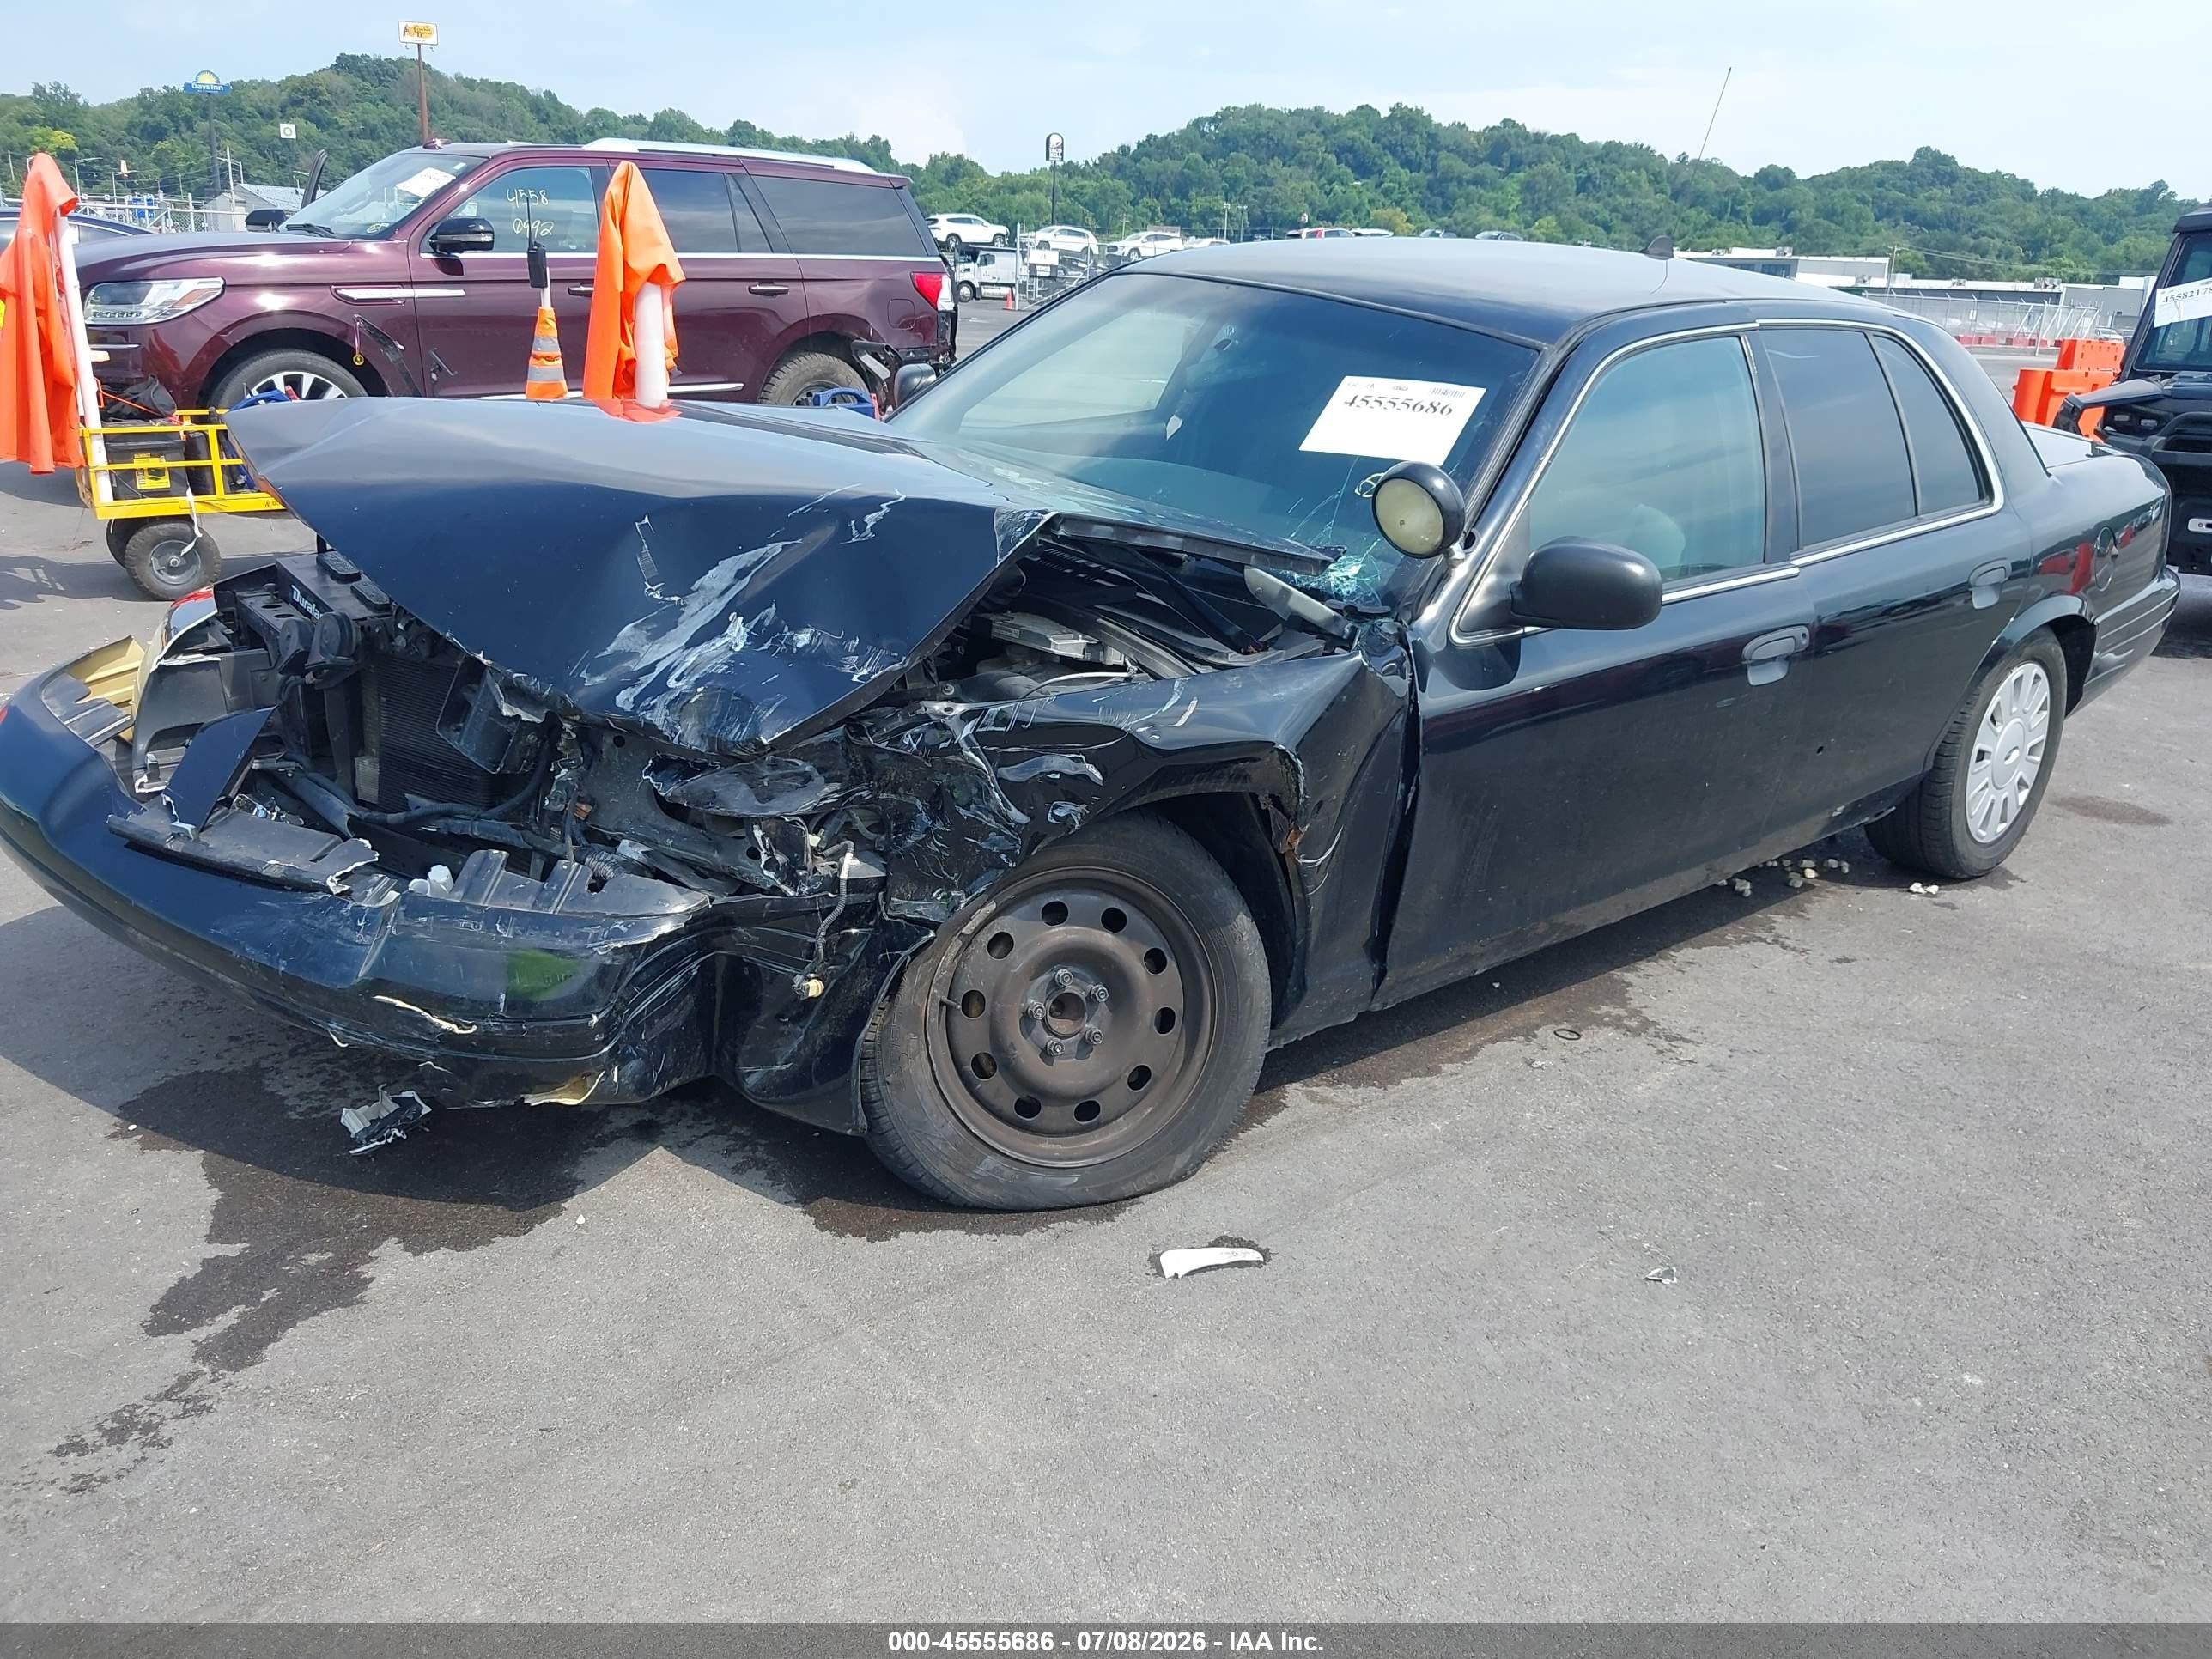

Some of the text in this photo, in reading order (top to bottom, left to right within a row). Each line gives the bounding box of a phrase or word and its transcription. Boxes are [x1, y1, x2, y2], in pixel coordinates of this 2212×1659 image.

[507, 188, 549, 208] 4558
[513, 218, 555, 238] 0992
[1344, 394, 1453, 416] 45555686
